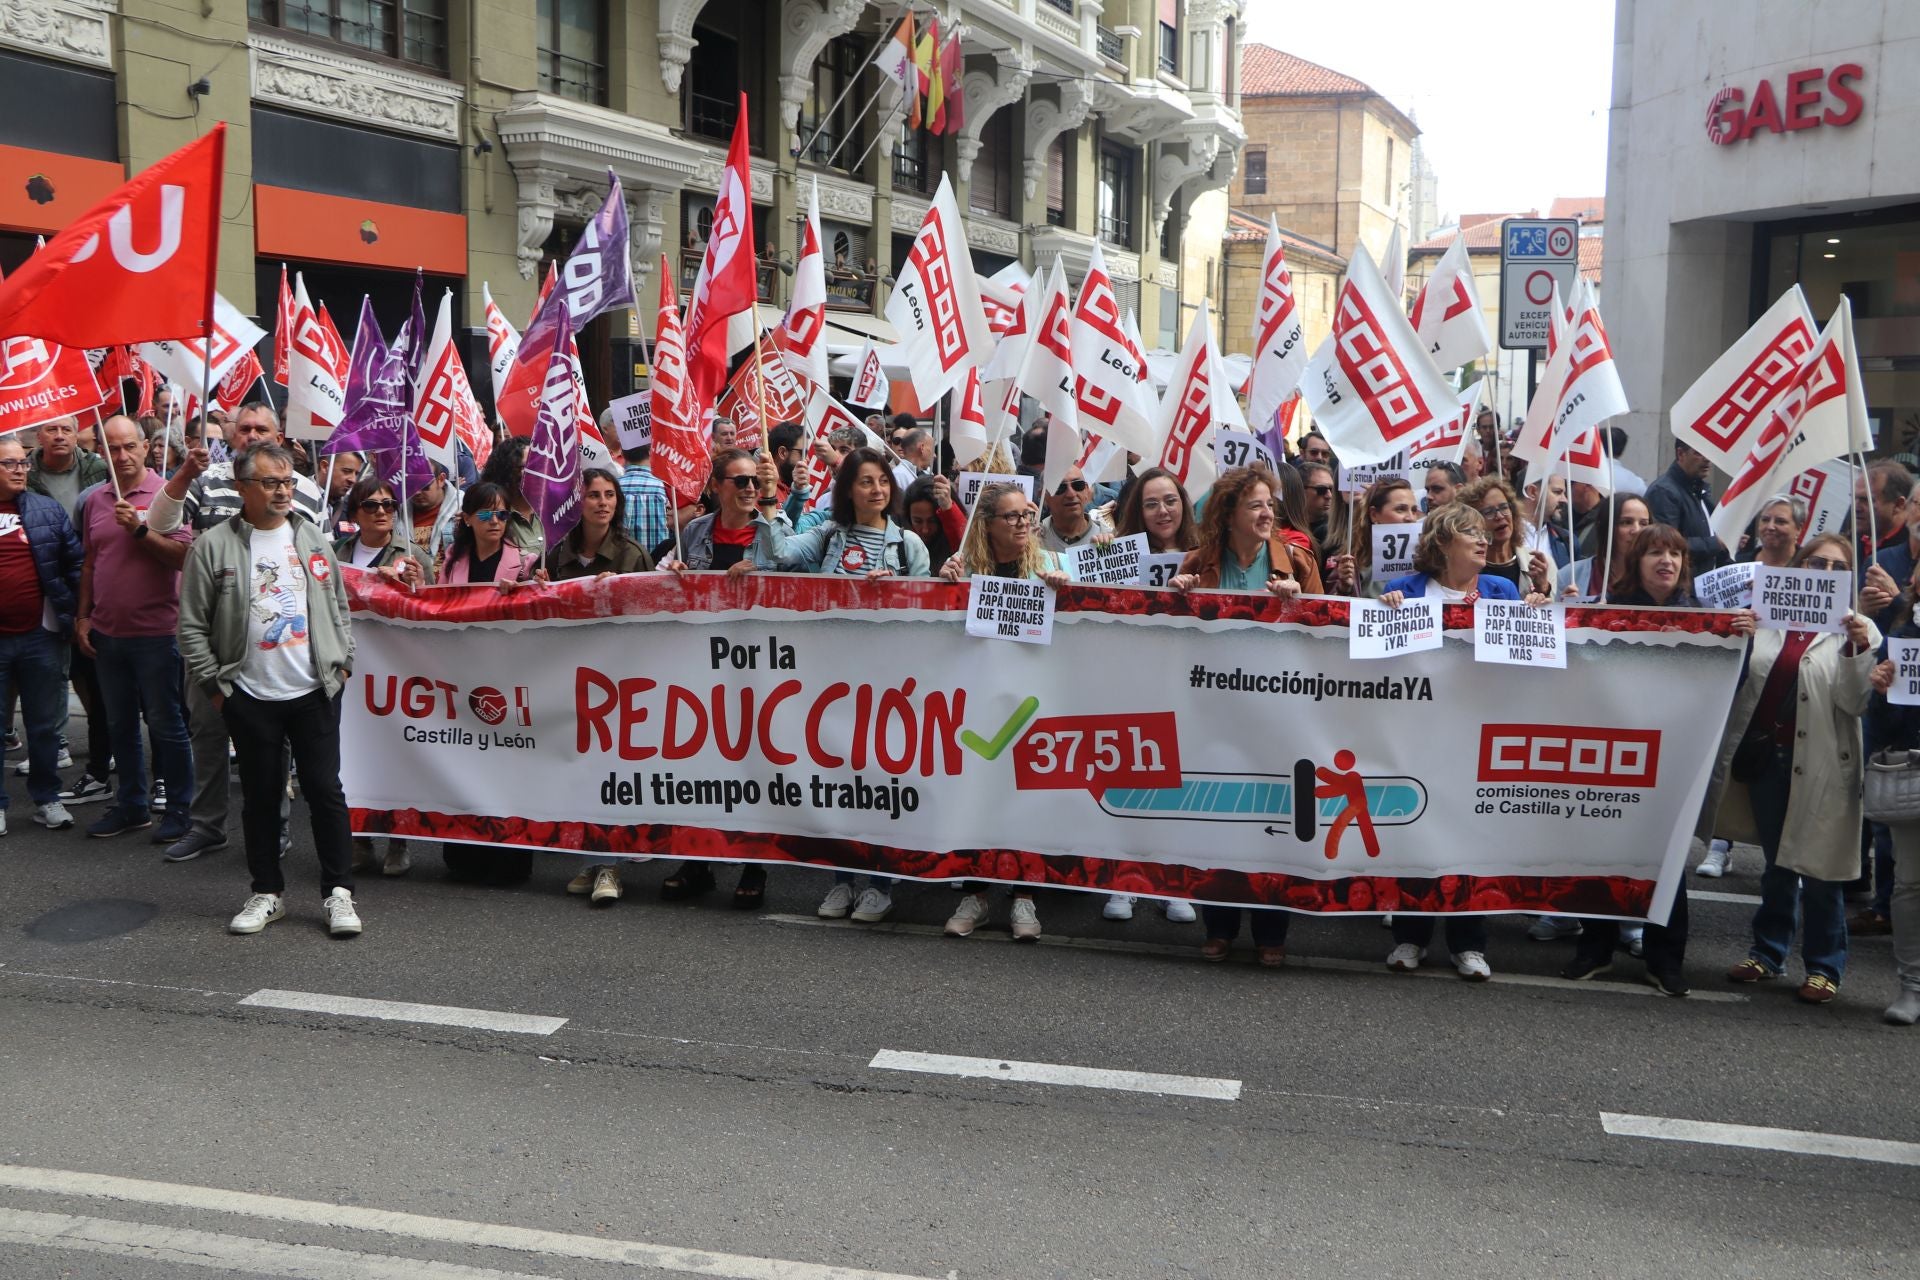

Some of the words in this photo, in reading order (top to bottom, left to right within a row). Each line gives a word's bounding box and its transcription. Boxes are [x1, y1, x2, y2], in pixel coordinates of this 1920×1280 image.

[1705, 63, 1864, 145] GAES
[1555, 236, 1567, 247] 10
[826, 285, 858, 298] ENCIANO
[911, 216, 966, 362] CCOO
[900, 282, 925, 331] León
[1509, 331, 1550, 339] AUTORIZ
[309, 374, 343, 407] León
[626, 402, 652, 418] TRAB
[622, 415, 652, 431] MENO
[1078, 548, 1095, 562] LOS
[1126, 539, 1138, 551] DE
[1078, 557, 1103, 575] PAPÁ
[1100, 566, 1140, 583] TRABAJE
[982, 581, 999, 594] LOS
[1002, 581, 1030, 597] NIÑOS
[1032, 586, 1045, 599] DE
[1816, 579, 1836, 594] ME
[979, 593, 1004, 608] PAPÁ
[1006, 597, 1045, 612] QUIEREN
[1762, 591, 1821, 609] PRESENTO
[1824, 596, 1833, 610] A
[976, 607, 994, 620] QUE
[998, 610, 1044, 625] TRABAJES
[1362, 603, 1430, 623] REDUCCIÓN
[1487, 604, 1506, 617] LOS
[1509, 603, 1538, 620] NIÑOS
[1540, 609, 1553, 621] DE
[1771, 608, 1828, 625] DIPUTADO
[997, 621, 1019, 637] MÁS
[1358, 624, 1374, 638] DE
[1378, 617, 1435, 638] JORNADA
[1485, 617, 1512, 632] PAPÁ
[1514, 620, 1555, 635] QUIEREN
[1385, 634, 1409, 652] ¡YA!
[1484, 631, 1504, 645] QUE
[1506, 634, 1556, 650] TRABAJES
[709, 636, 761, 670] Por
[768, 636, 797, 670] la
[1509, 646, 1533, 661] MÁS
[1189, 664, 1433, 701] #reducciónjornadaYA
[365, 673, 479, 720] UGT
[575, 666, 967, 778] REDUCCIÓN
[402, 724, 473, 746] Castilla
[477, 732, 489, 751] y
[493, 731, 536, 750] León
[1489, 735, 1649, 776] CCOO
[600, 771, 643, 806] del
[650, 772, 761, 814] tiempo
[767, 772, 803, 808] de
[809, 774, 920, 820] trabajo
[1475, 784, 1571, 801] comisiones
[1575, 787, 1641, 804] obreras
[1474, 800, 1495, 815] de
[1498, 800, 1561, 816] Castilla
[1564, 805, 1576, 820] y
[1579, 804, 1623, 819] León
